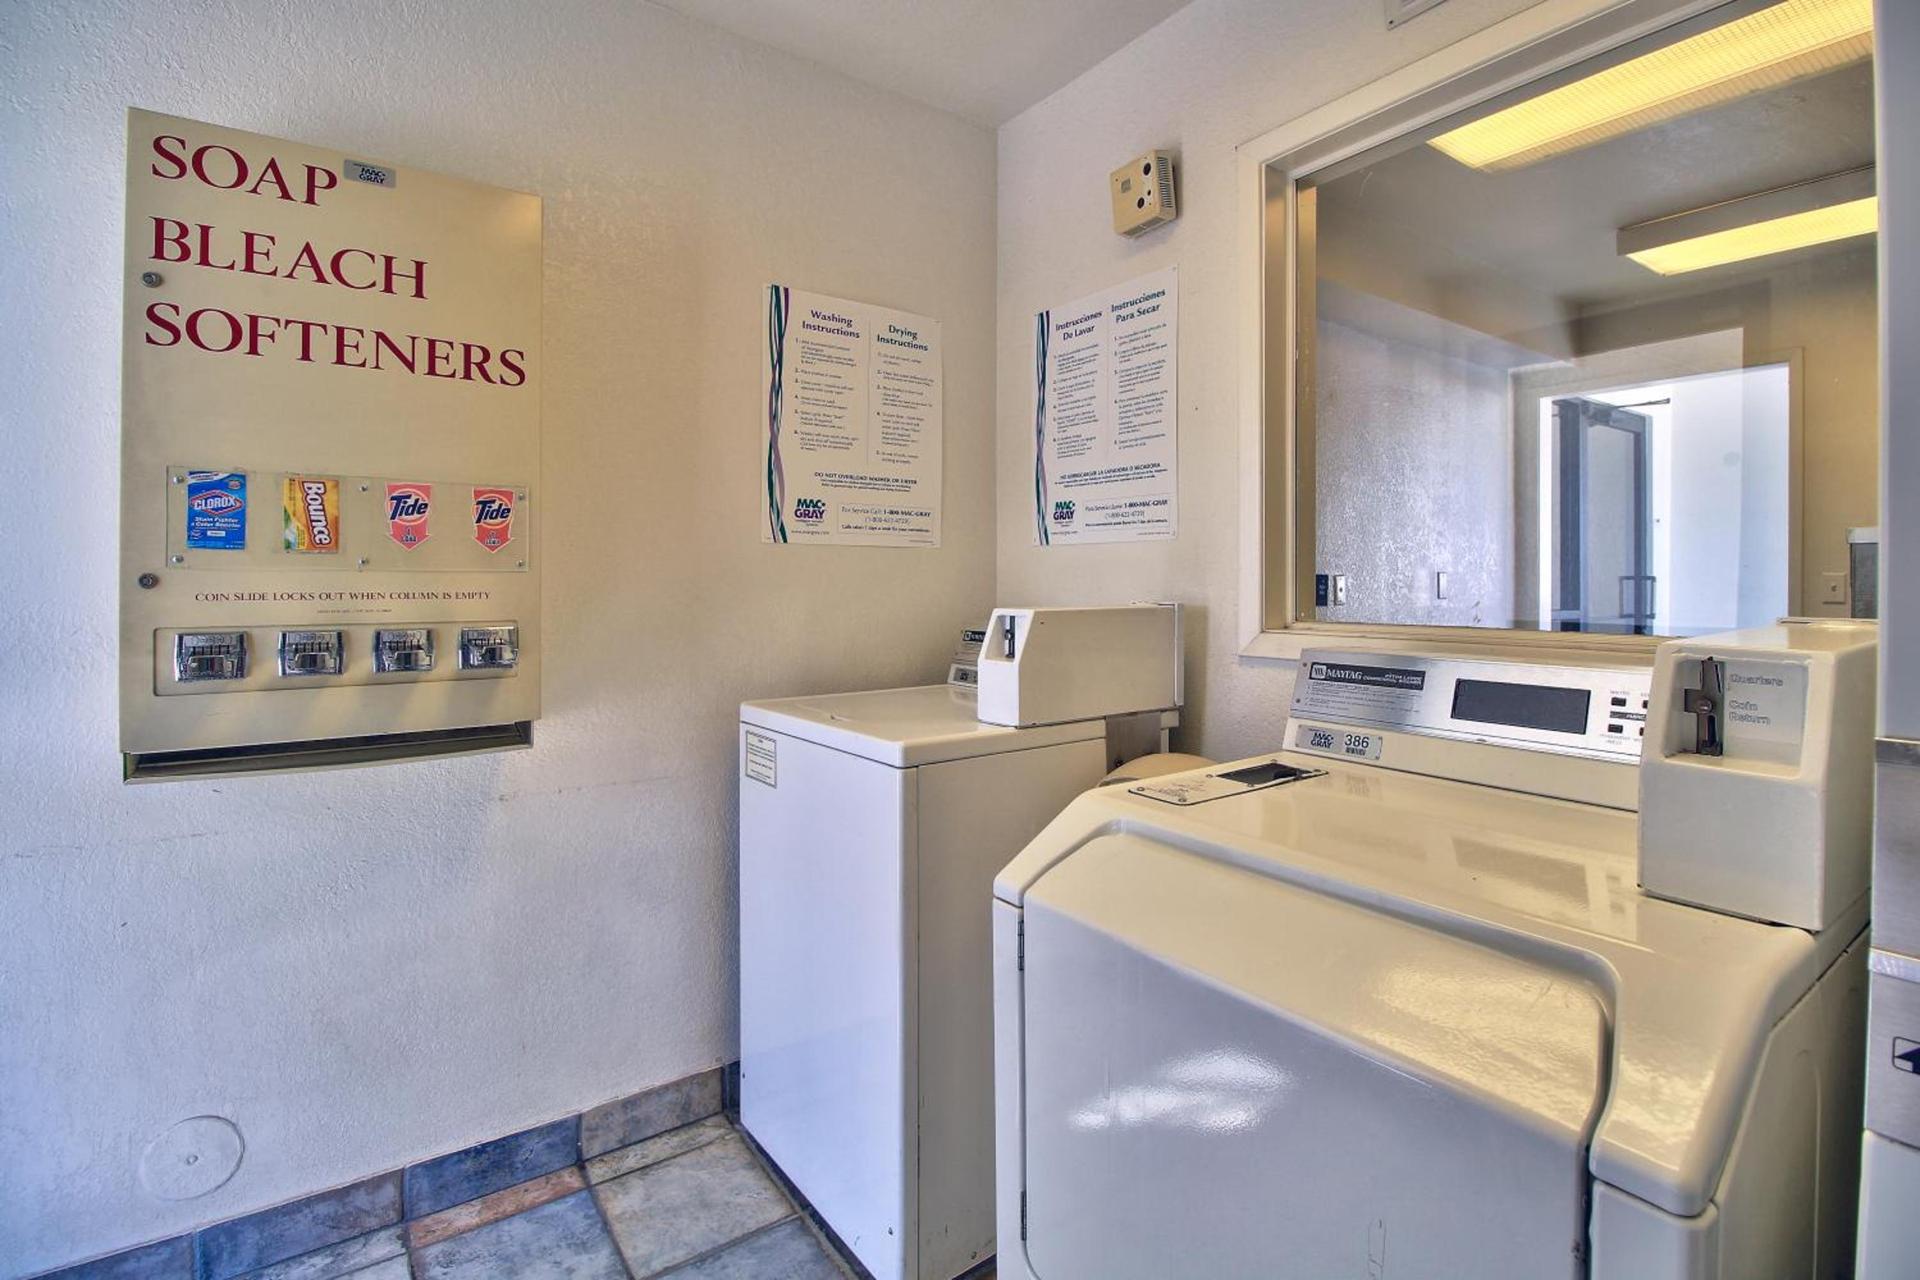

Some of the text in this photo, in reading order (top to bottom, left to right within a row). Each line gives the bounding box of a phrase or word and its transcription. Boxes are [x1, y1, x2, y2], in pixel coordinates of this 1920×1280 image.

[152, 135, 338, 207] SOAP
[147, 216, 430, 300] BLEACH
[1111, 289, 1166, 313] Instrucciones
[810, 309, 853, 328] Washing
[1055, 311, 1102, 332] Instrucciones
[1115, 303, 1161, 324] Para Secar
[802, 320, 860, 339] Instructions
[888, 324, 918, 341] Drying
[1062, 324, 1095, 341] De Lavar
[145, 302, 526, 387] SOFTENERS
[877, 334, 929, 351] Instructions
[194, 496, 236, 510] CLOROX
[390, 494, 429, 520] Tide
[475, 499, 511, 524] Tide
[303, 482, 332, 545] Bounce
[794, 508, 826, 519] GRAY
[1053, 510, 1075, 520] GRAY
[195, 592, 231, 601] COIN
[234, 592, 269, 601] SLIDE
[273, 592, 315, 601] LOCKS
[319, 592, 344, 600] OUT
[349, 592, 386, 600] WHEN
[389, 592, 439, 600] COLUMN
[442, 592, 452, 600] IS
[1327, 669, 1362, 680] MAYTAG
[1729, 673, 1784, 687] Quarters
[1728, 699, 1759, 711] Coin
[1729, 711, 1771, 725] Return
[1344, 734, 1370, 749] 386
